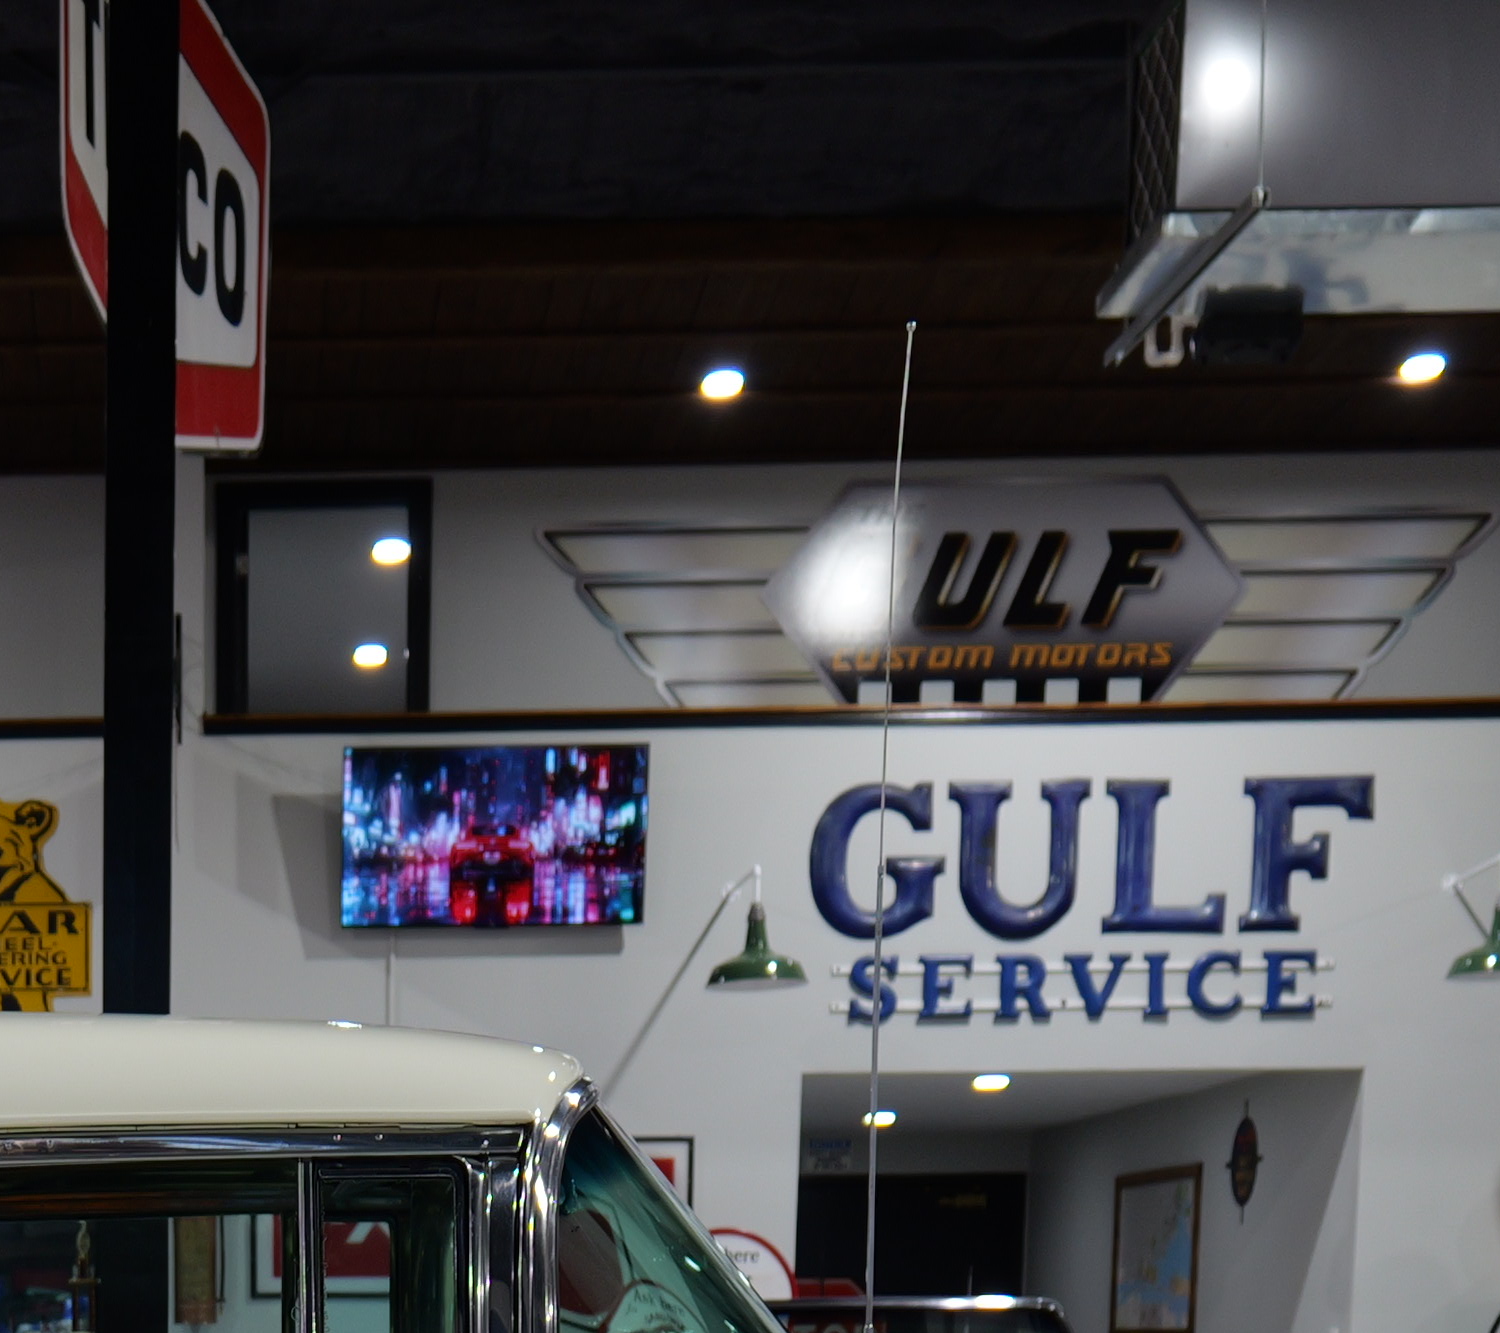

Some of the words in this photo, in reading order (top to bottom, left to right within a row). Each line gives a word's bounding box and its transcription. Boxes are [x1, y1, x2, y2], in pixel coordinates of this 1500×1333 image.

[908, 529, 1184, 631] ULF
[832, 643, 996, 672] CUSTOM
[1009, 641, 1174, 669] MOTORS
[807, 774, 1376, 941] GULF
[844, 949, 1321, 1027] SERVICE
